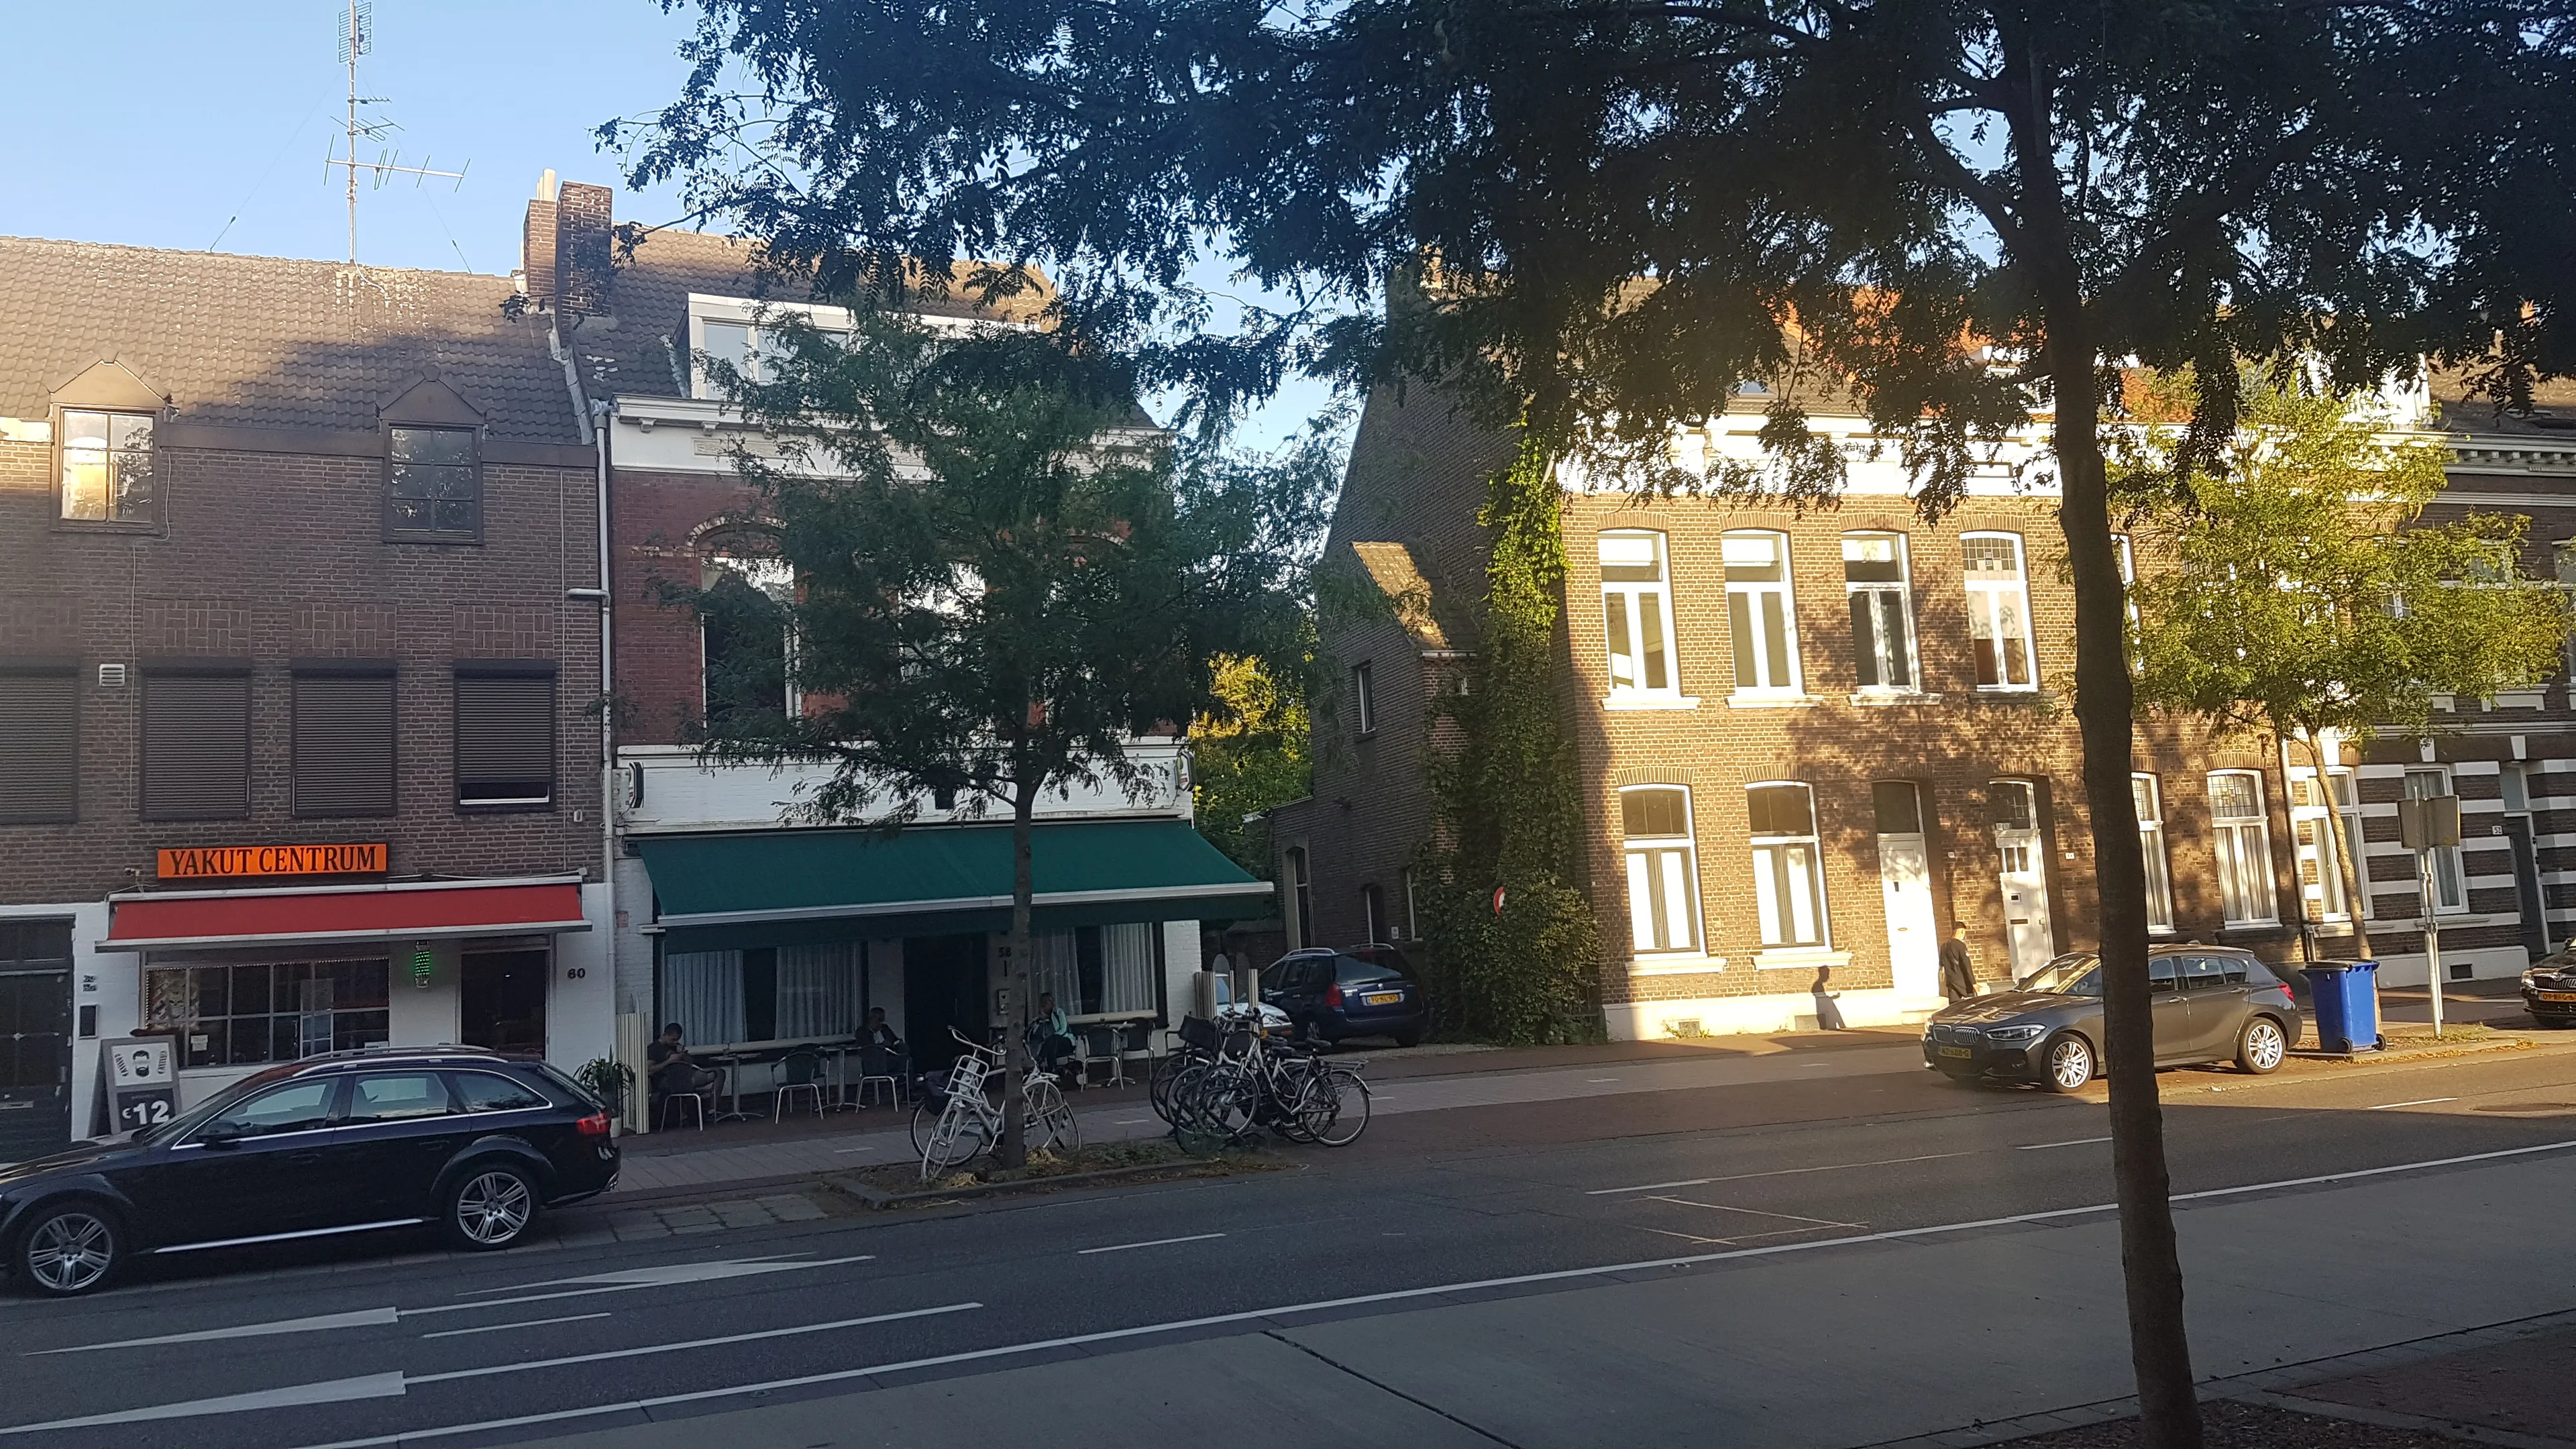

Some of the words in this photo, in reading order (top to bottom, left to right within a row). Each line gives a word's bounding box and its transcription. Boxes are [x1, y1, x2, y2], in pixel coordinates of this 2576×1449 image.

[170, 849, 253, 875] YAKUT
[258, 845, 376, 872] CENTRUM
[567, 967, 586, 979] 60
